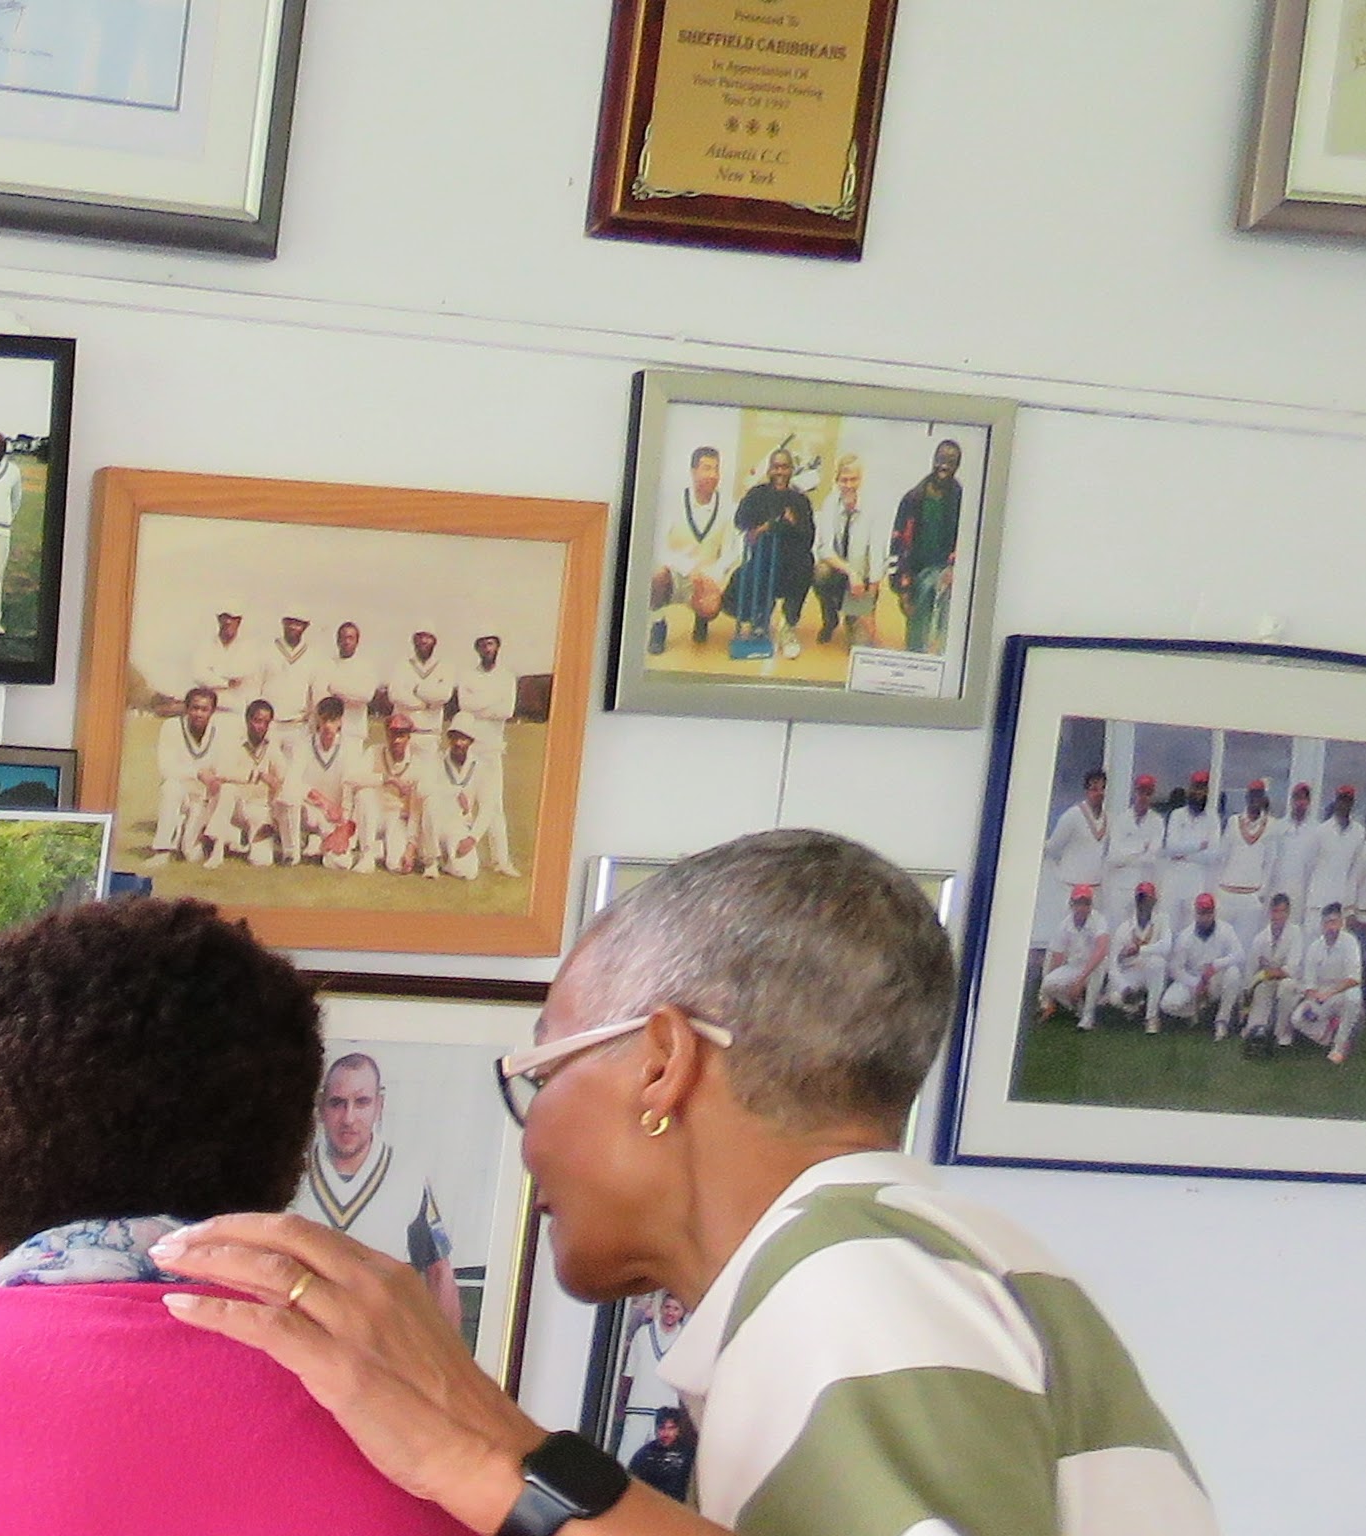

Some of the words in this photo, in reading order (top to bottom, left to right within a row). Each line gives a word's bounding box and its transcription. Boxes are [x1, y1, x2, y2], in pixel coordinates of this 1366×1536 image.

[678, 29, 754, 50] SHEFFIELD
[756, 39, 847, 60] CARIBBEANS
[716, 166, 744, 182] New
[749, 169, 775, 185] York
